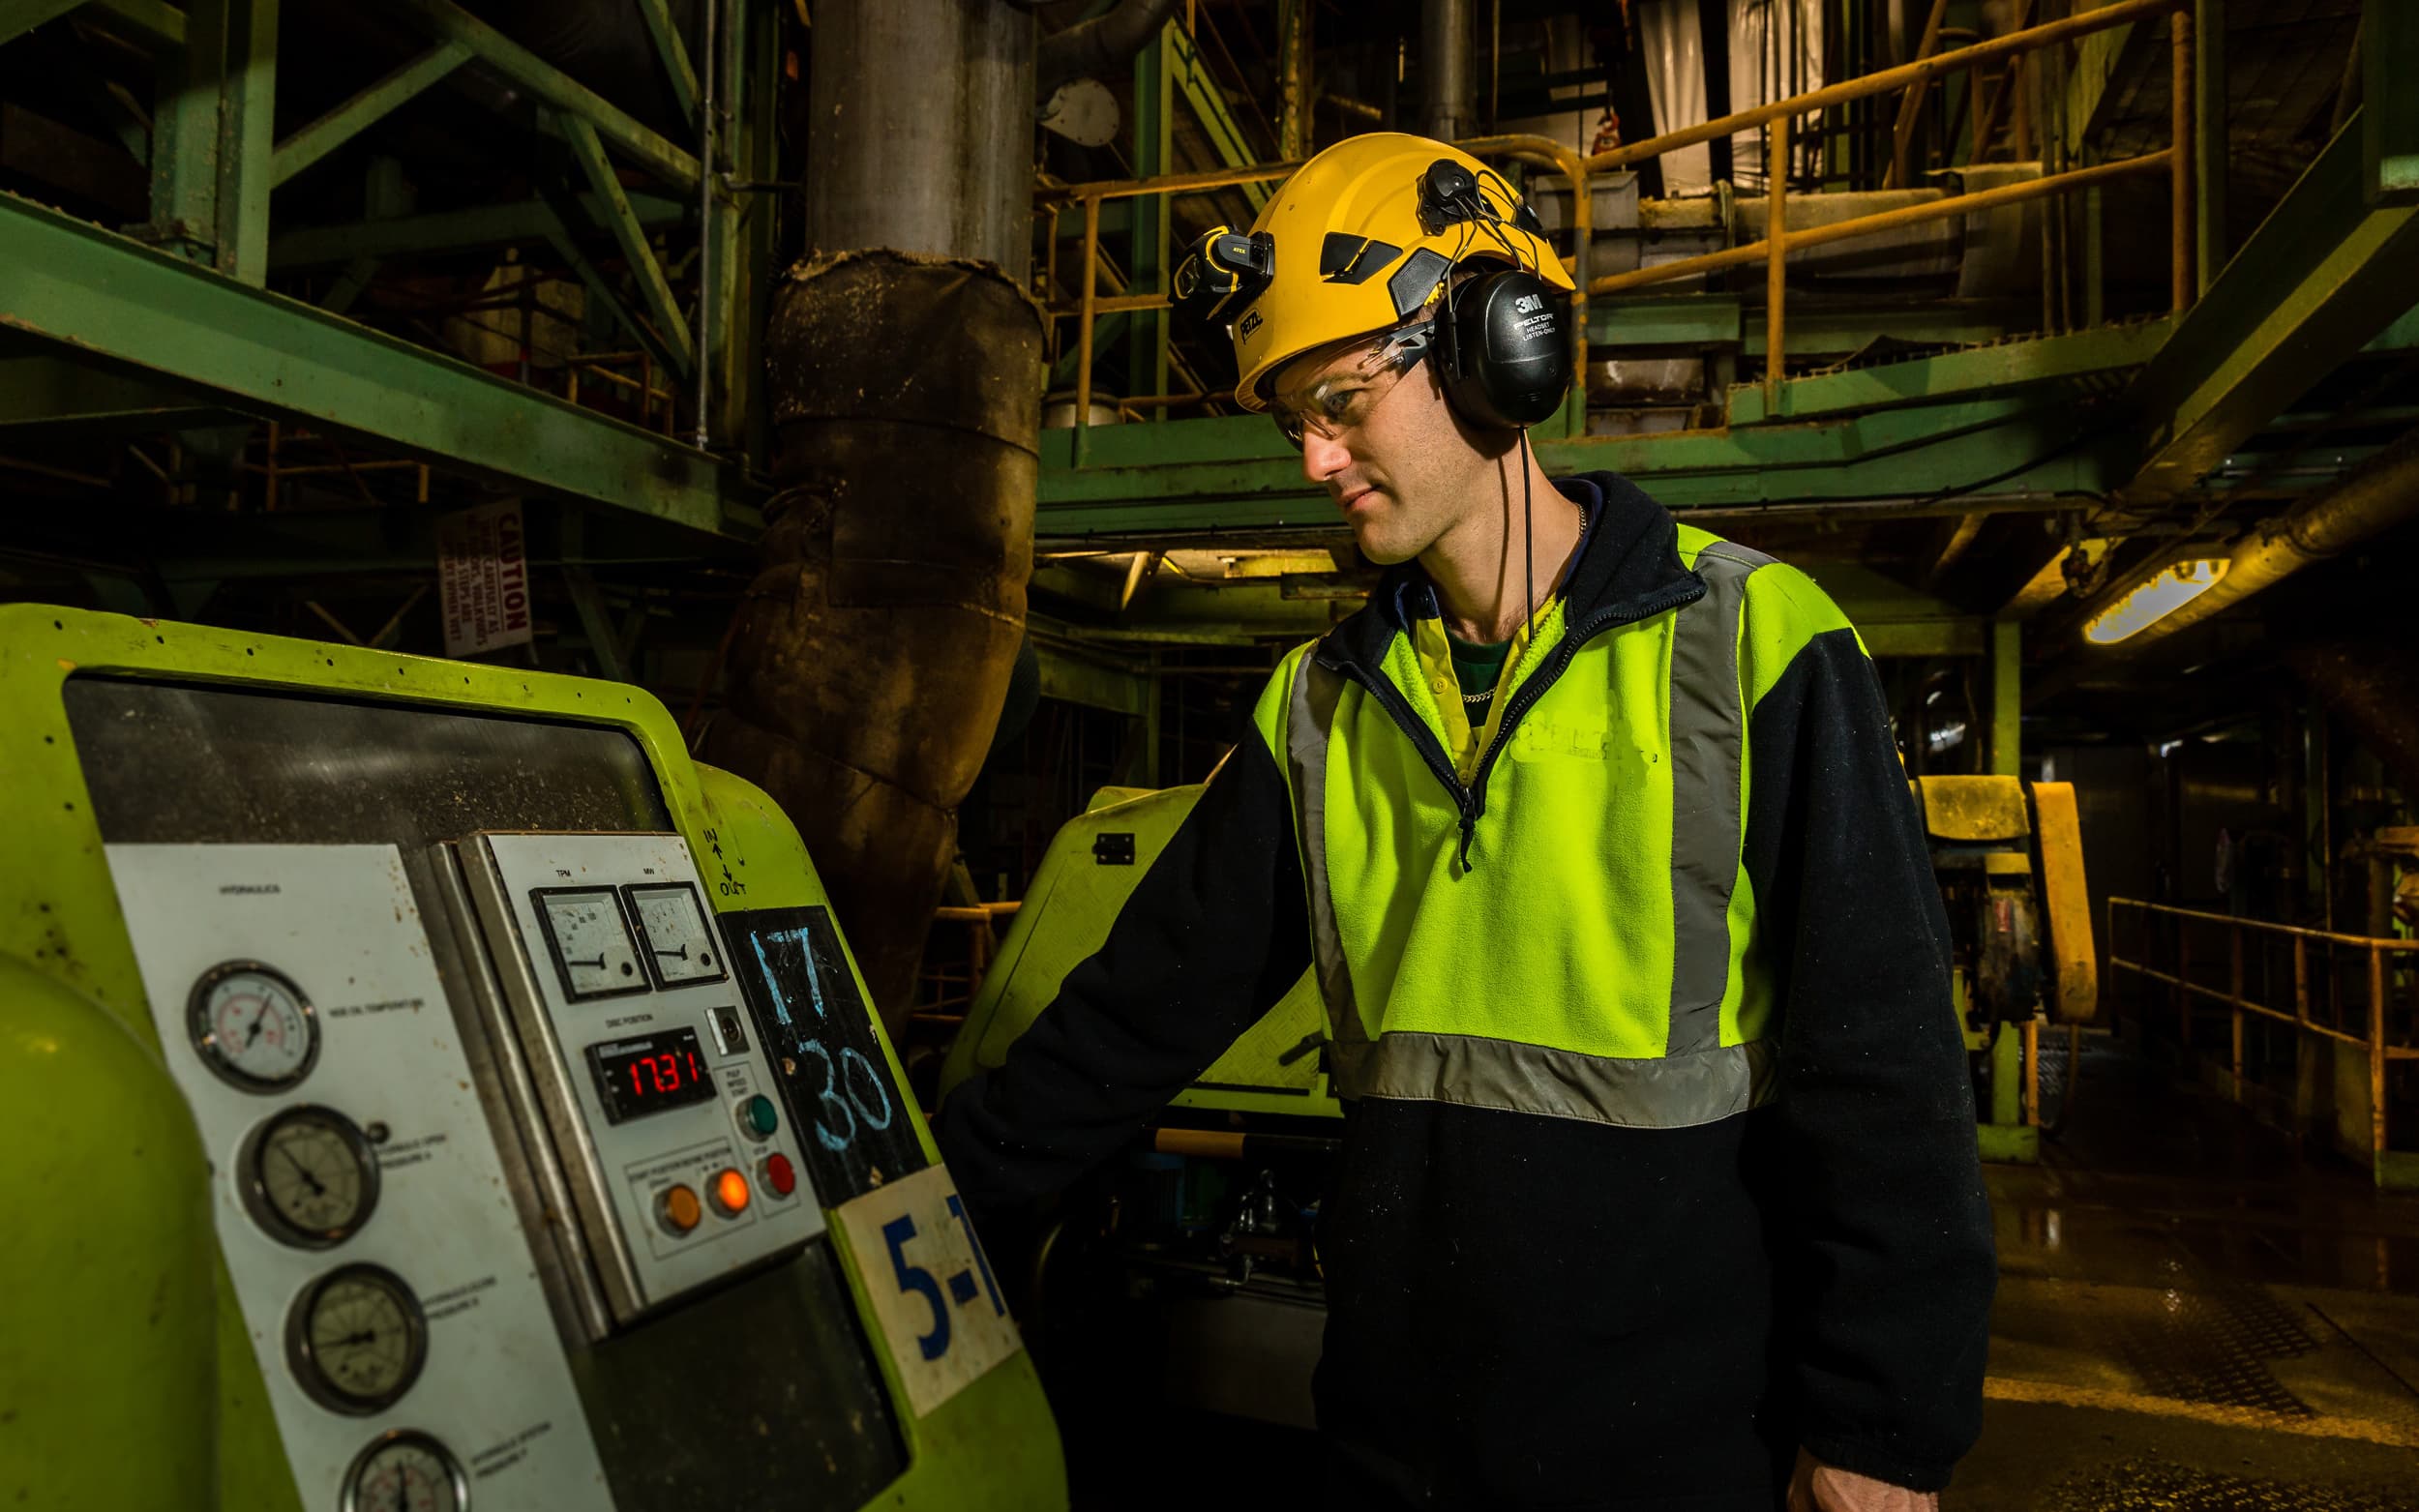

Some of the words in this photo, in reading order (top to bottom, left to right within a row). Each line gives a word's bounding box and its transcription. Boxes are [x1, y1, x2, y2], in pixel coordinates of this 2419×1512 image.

[1513, 313, 1554, 330] PELTOR
[1515, 294, 1543, 313] 3M
[498, 512, 527, 630] CAUTION
[702, 828, 718, 843] IN
[720, 881, 747, 897] OUT
[750, 926, 825, 1025] 17
[797, 1038, 892, 1151] 30
[882, 1195, 1005, 1360] 5-1
